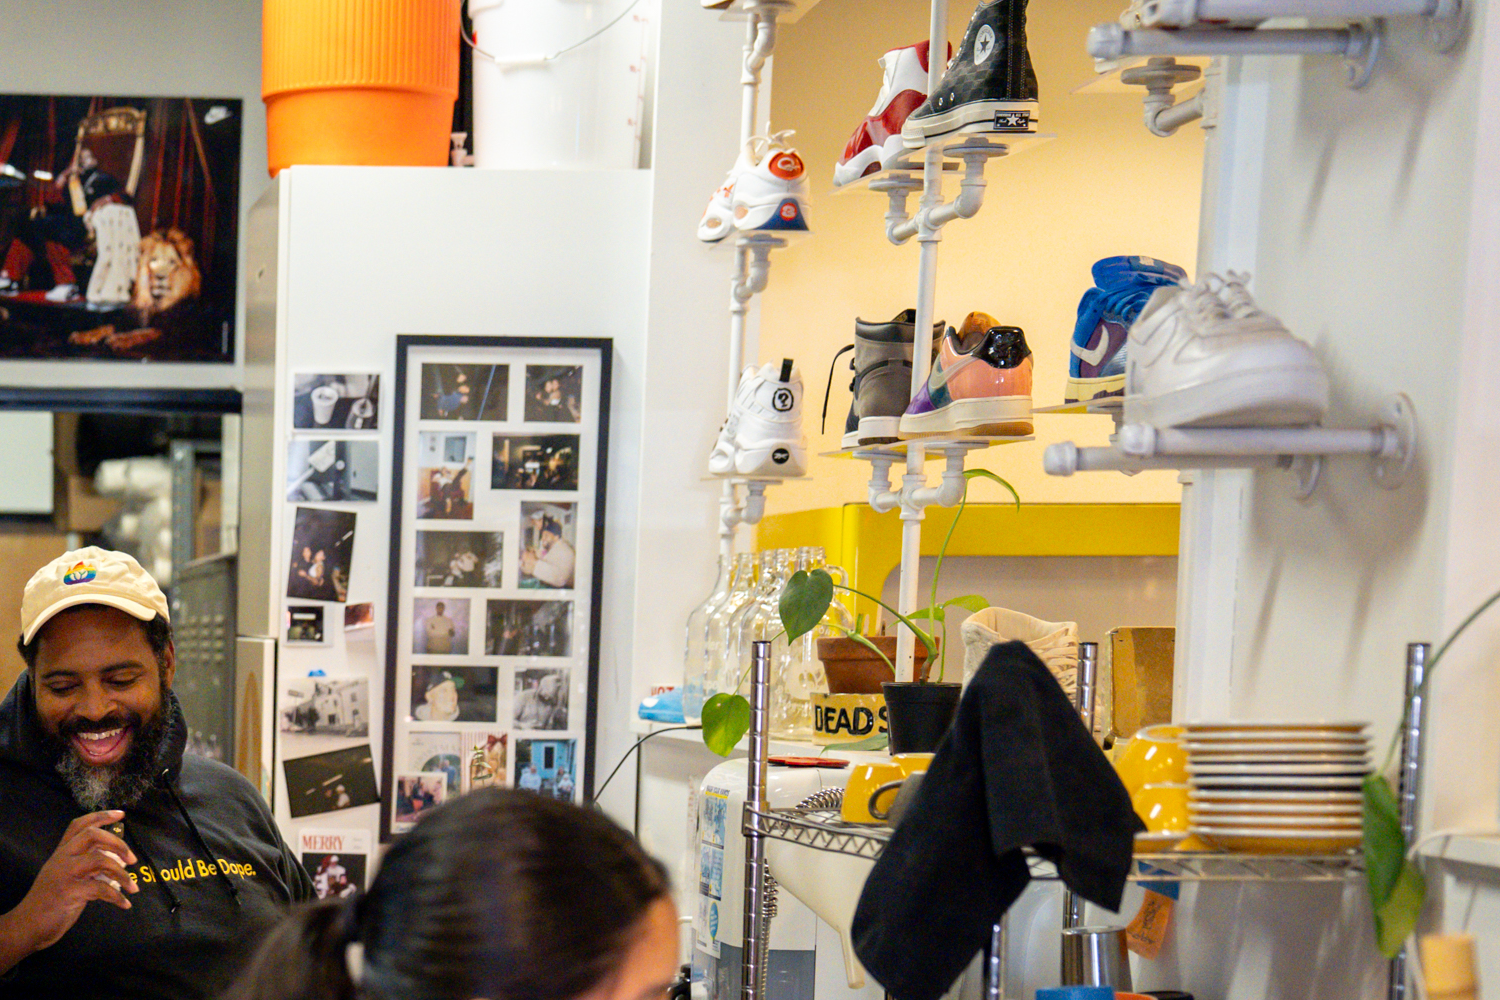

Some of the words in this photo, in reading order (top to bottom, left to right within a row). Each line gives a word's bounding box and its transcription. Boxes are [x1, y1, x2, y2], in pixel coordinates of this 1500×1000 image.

[302, 834, 345, 851] MERRY
[196, 859, 217, 877] Be
[216, 858, 257, 880] Dope.
